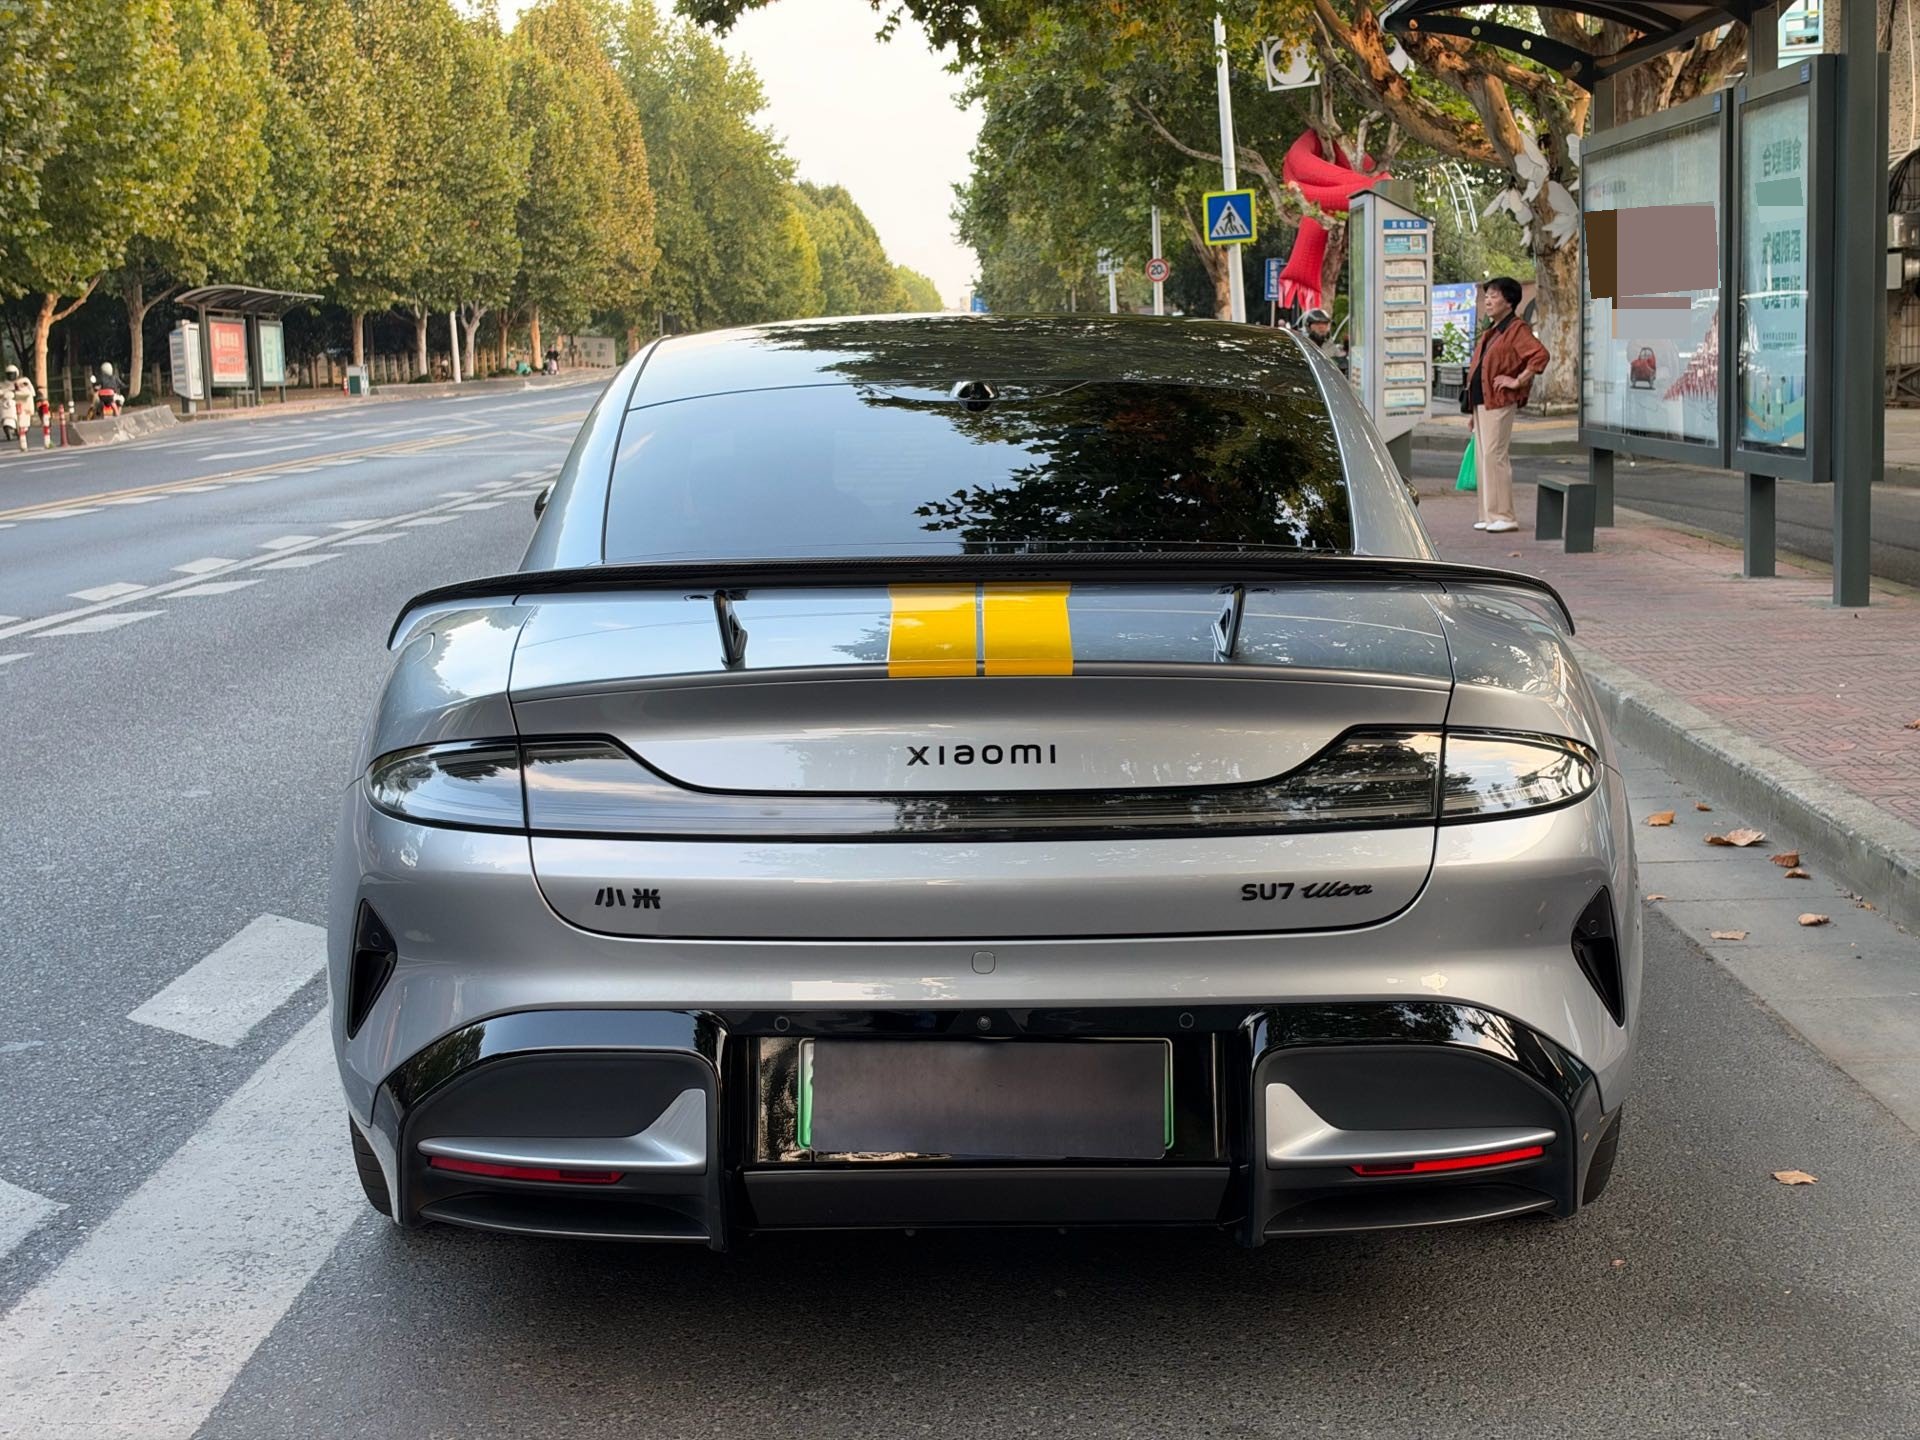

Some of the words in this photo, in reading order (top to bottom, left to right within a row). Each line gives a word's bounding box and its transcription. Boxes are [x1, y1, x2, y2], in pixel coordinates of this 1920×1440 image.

[907, 744, 1056, 766] xiaomi
[594, 887, 661, 909] 小米
[1241, 882, 1295, 901] SU7
[1301, 881, 1373, 899] Ultra
